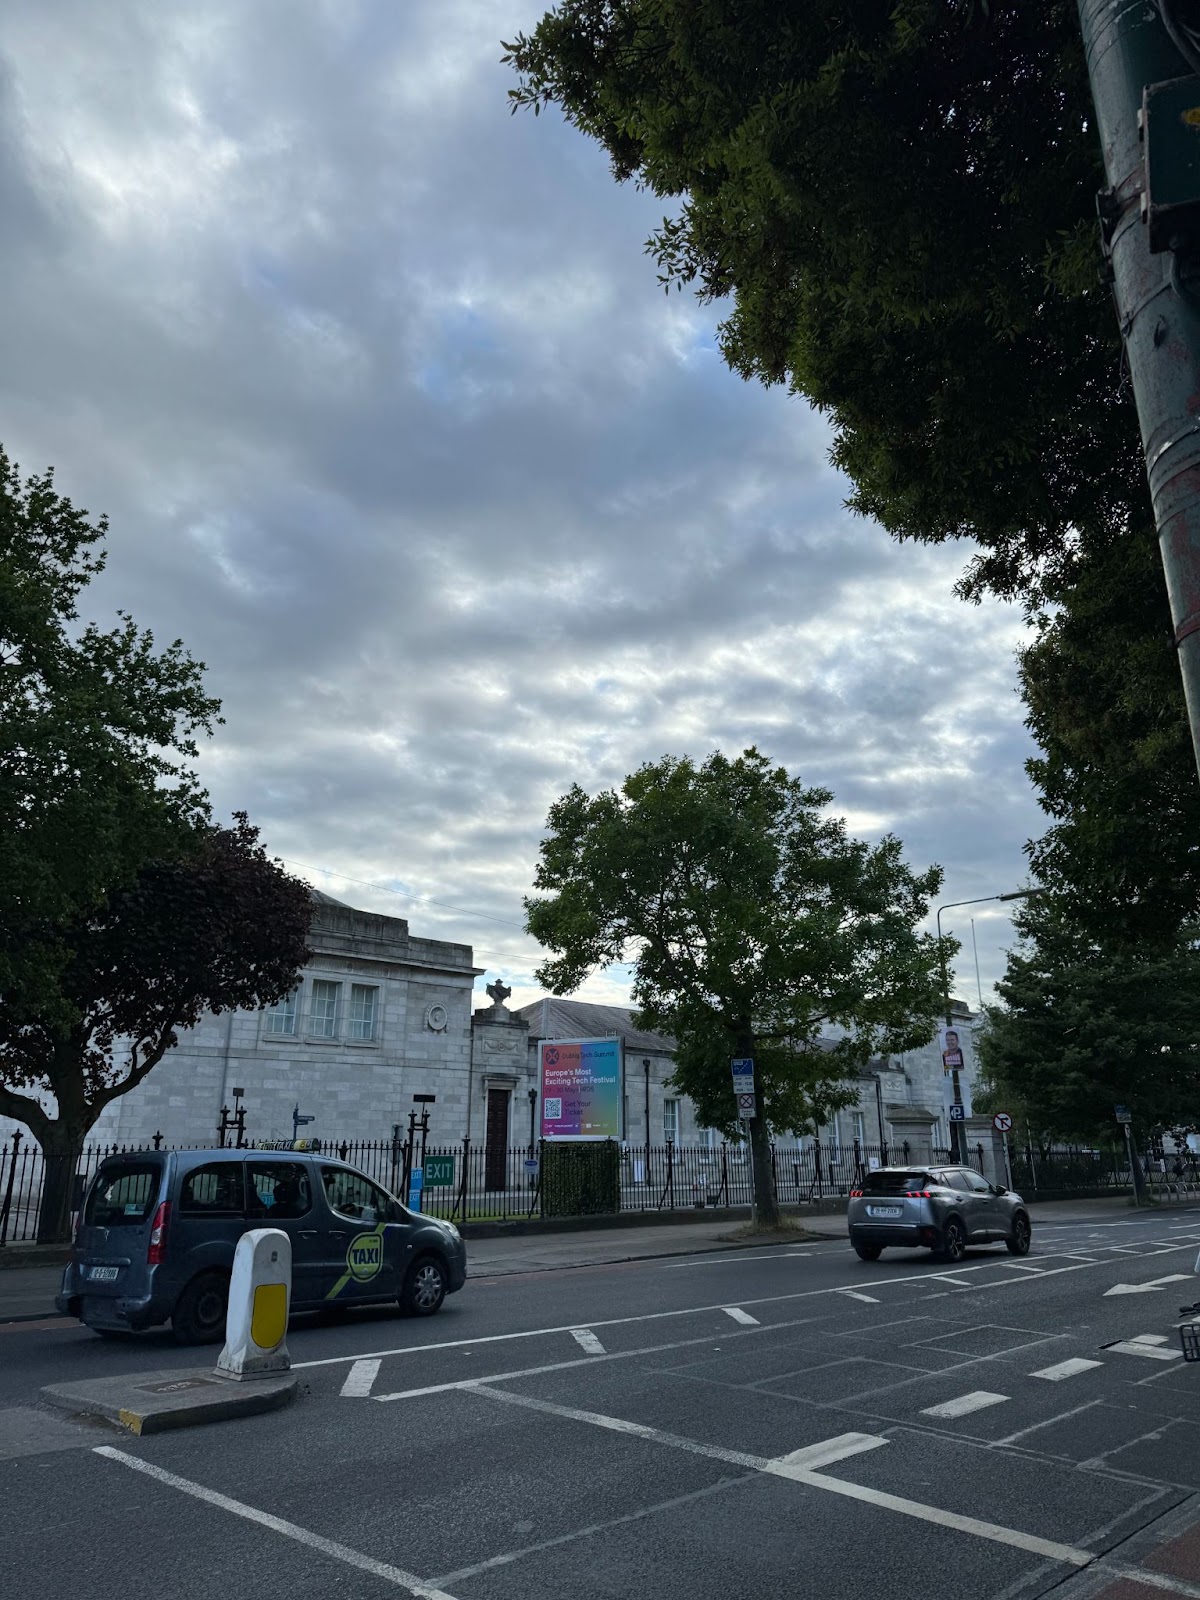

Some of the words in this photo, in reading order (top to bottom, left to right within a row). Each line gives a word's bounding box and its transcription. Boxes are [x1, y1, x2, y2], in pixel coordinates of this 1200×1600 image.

[594, 1050, 615, 1058] Summit
[545, 1069, 574, 1078] Europe's
[545, 1077, 571, 1086] Exciting
[589, 1076, 616, 1084] Festival
[564, 1100, 576, 1108] Get
[564, 1108, 584, 1116] Ticket
[411, 1171, 422, 1179] EXIT
[425, 1163, 452, 1179] EXIT
[409, 1193, 420, 1202] EXIT
[352, 1248, 379, 1265] TAXI
